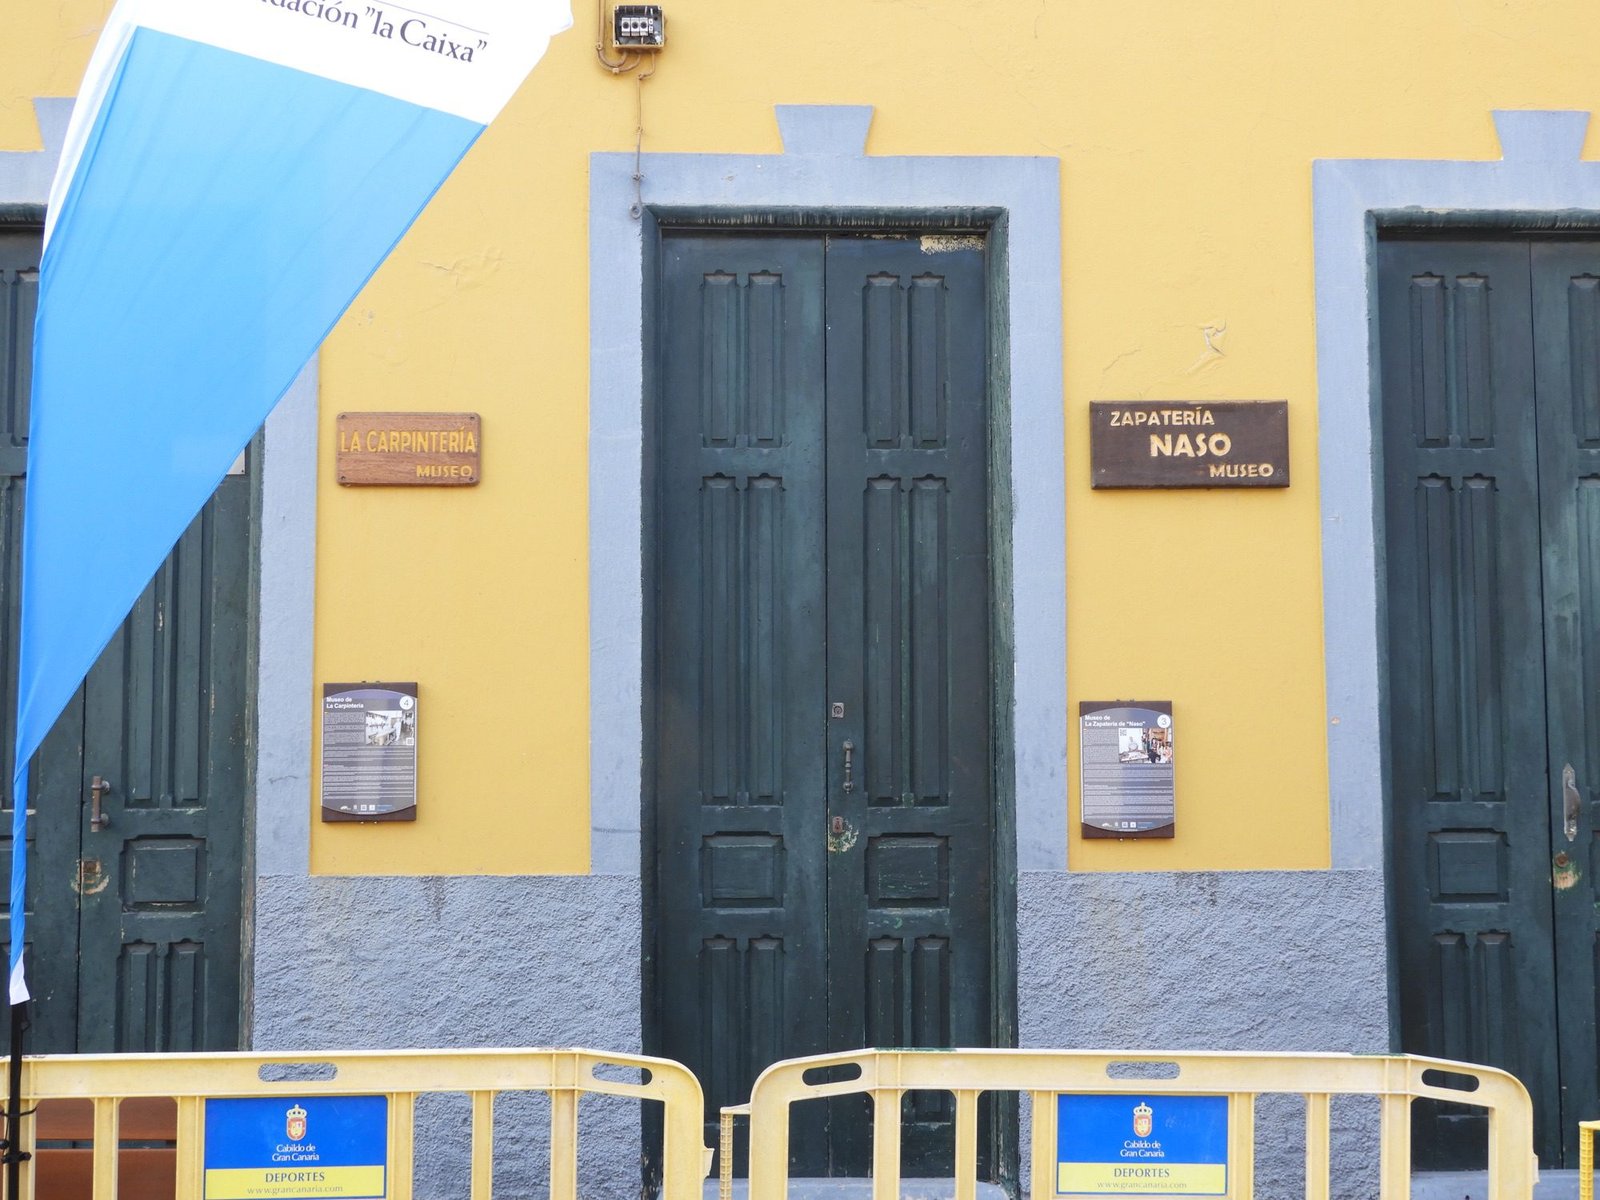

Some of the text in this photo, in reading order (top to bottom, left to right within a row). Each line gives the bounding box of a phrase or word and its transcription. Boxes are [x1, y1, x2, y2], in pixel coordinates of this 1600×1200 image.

[262, 0, 359, 29] ación
[1110, 407, 1215, 427] ZAPATERÍA
[341, 426, 477, 453] LA CARPINTERÍA
[1150, 432, 1232, 457] NASO
[416, 464, 473, 478] MUSEO
[1209, 463, 1274, 478] MUSEO
[276, 1143, 316, 1153] Cabildo de
[1124, 1140, 1161, 1149] Cabildo de
[272, 1152, 320, 1162] Gran Canaria
[1120, 1149, 1165, 1158] Gran Canaria
[265, 1172, 325, 1183] DEPORTES
[1113, 1168, 1170, 1178] DEPORTES
[247, 1185, 344, 1195] www.grancanaria.com
[1097, 1180, 1187, 1190] www.grancanaria.com
